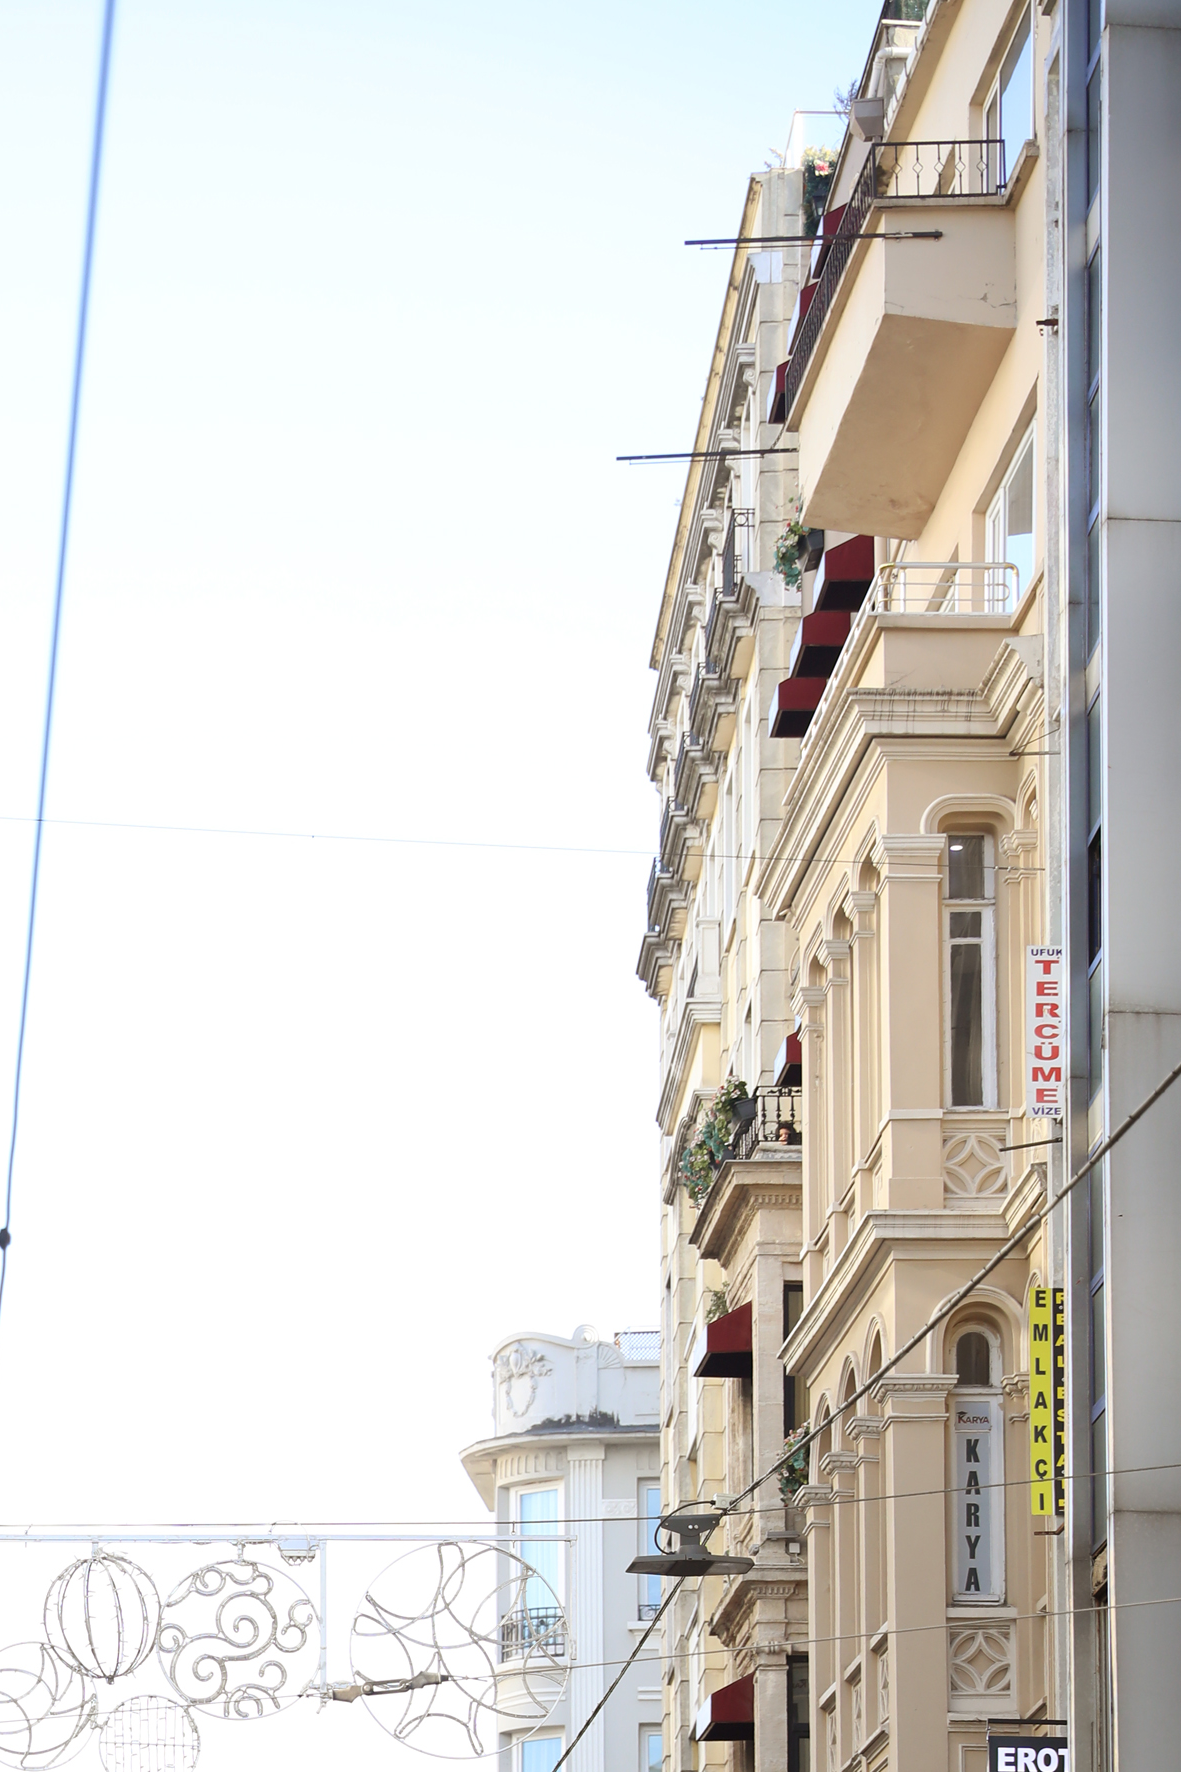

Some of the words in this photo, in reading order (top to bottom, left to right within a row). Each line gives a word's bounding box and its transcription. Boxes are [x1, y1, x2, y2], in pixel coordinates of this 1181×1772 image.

[1031, 948, 1063, 957] UFUK
[1031, 959, 1062, 1104] TERCÜME
[1032, 1105, 1062, 1116] VİZE
[957, 1412, 990, 1425] KARYA
[1032, 1289, 1049, 1512] EMLAKÇI
[964, 1438, 981, 1592] KARYA
